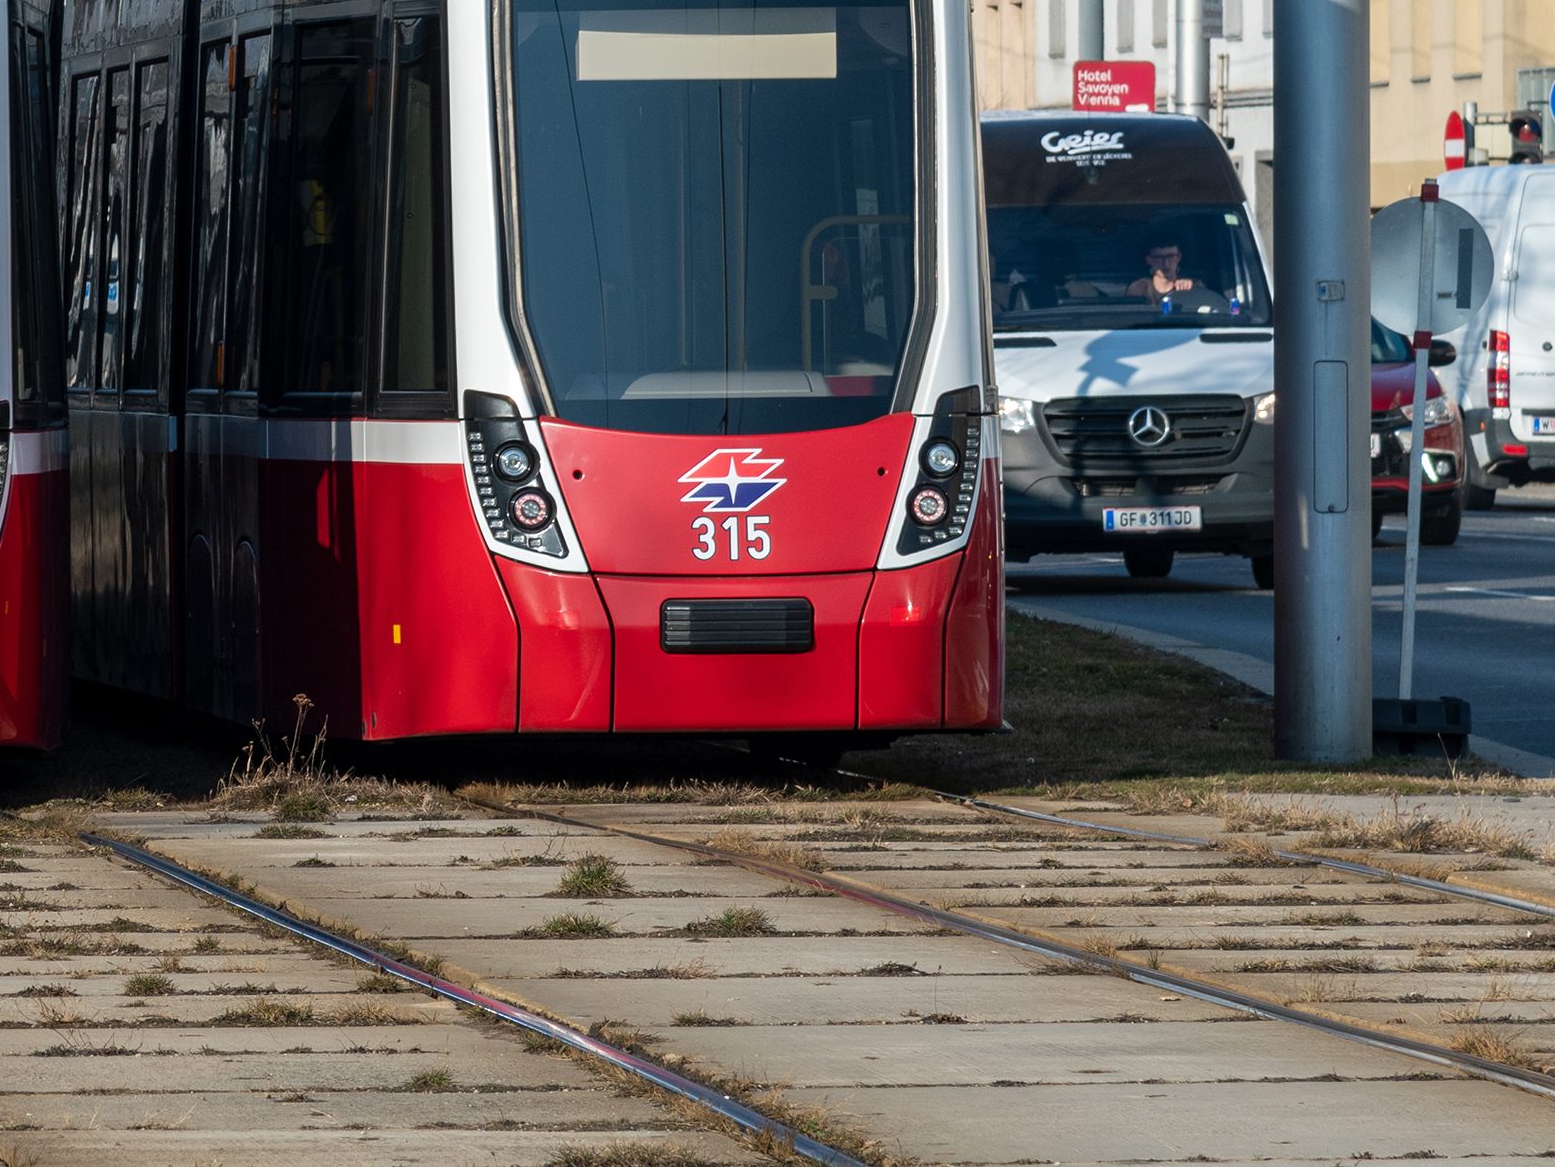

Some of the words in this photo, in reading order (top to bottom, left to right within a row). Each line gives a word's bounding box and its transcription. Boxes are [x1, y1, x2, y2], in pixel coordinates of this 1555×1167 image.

[1078, 69, 1111, 81] Hotel
[1078, 82, 1128, 95] Savoyen
[1077, 94, 1120, 106] Vienna
[1040, 130, 1124, 154] Geier
[1119, 512, 1137, 527] GF
[691, 515, 772, 561] 315
